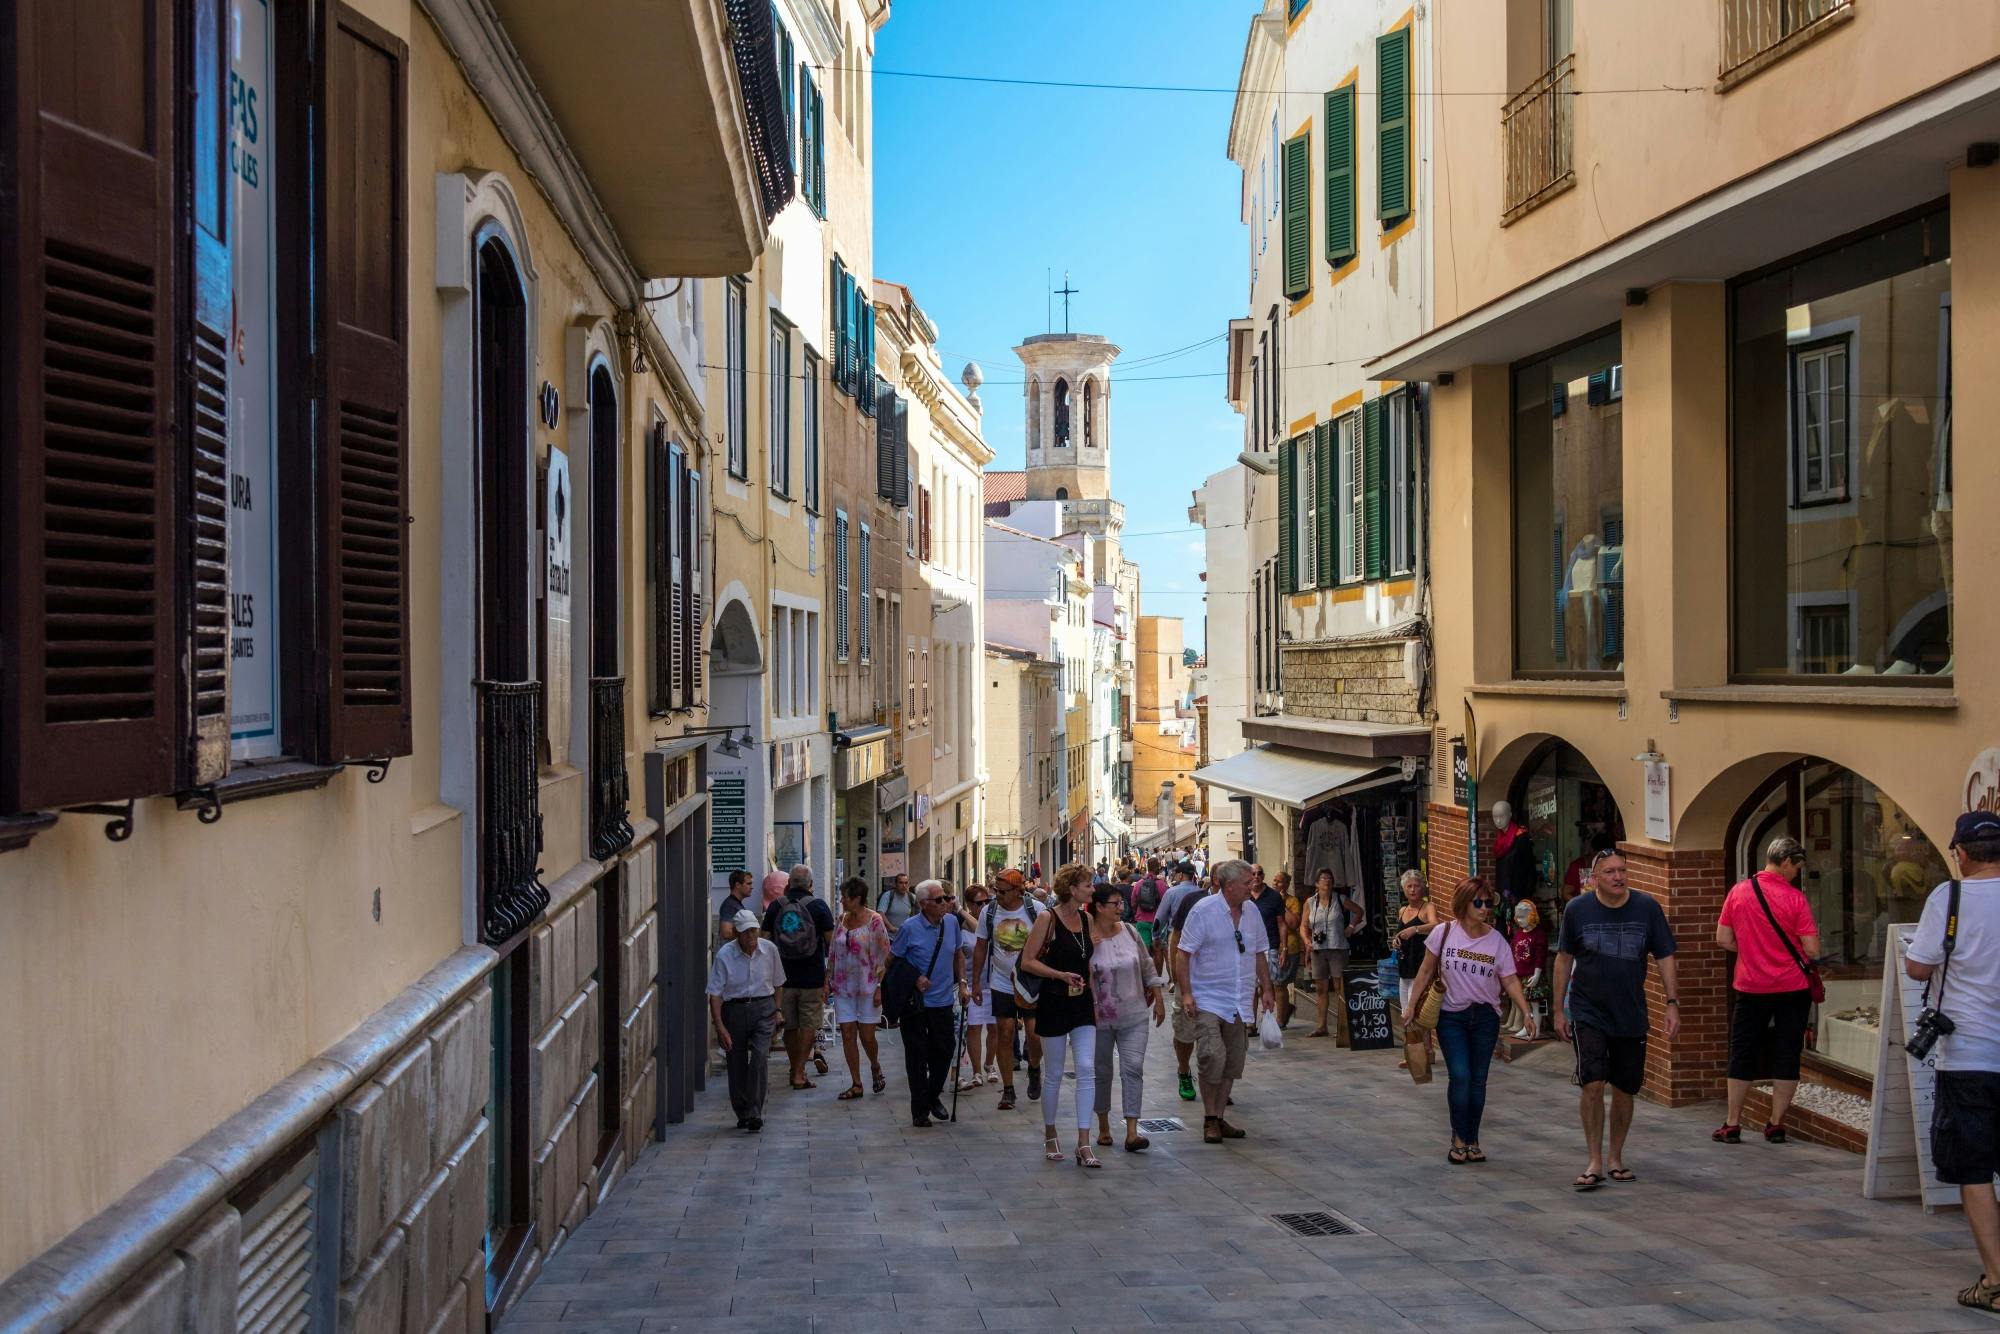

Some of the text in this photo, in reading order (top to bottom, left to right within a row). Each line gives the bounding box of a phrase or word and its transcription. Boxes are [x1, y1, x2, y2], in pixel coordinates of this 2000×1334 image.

[231, 472, 252, 511] URA
[1445, 947, 1456, 958] BE
[1445, 960, 1493, 977] STRONG
